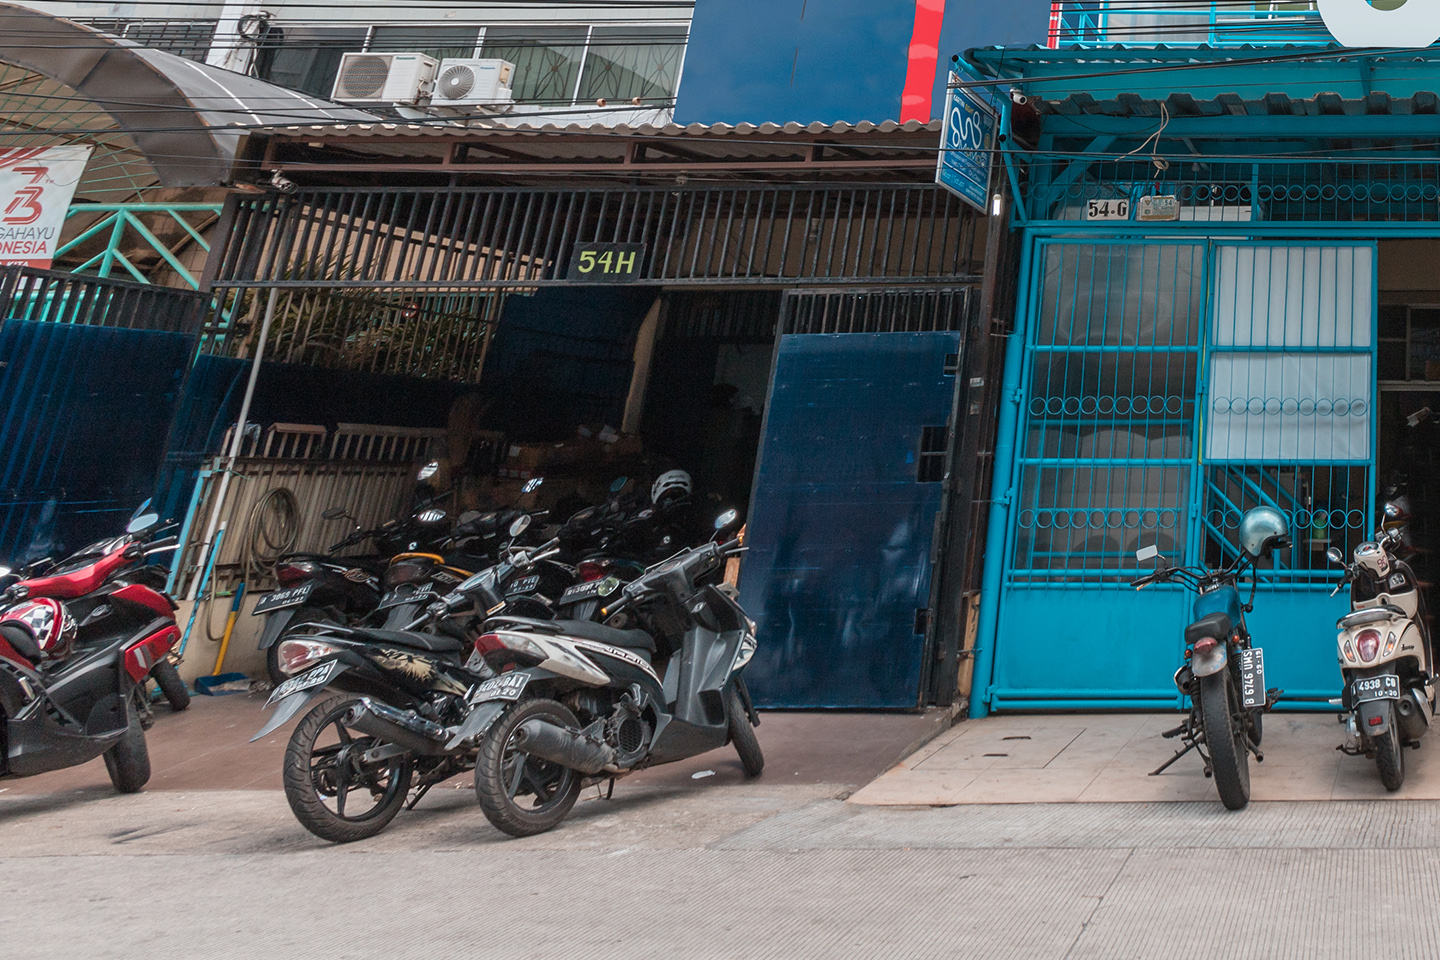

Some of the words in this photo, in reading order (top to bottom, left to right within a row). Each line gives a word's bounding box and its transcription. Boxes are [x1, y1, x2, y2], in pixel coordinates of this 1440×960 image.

[1243, 651, 1254, 671] UMS
[1243, 673, 1255, 696] 6746
[1358, 679, 1381, 691] 4938
